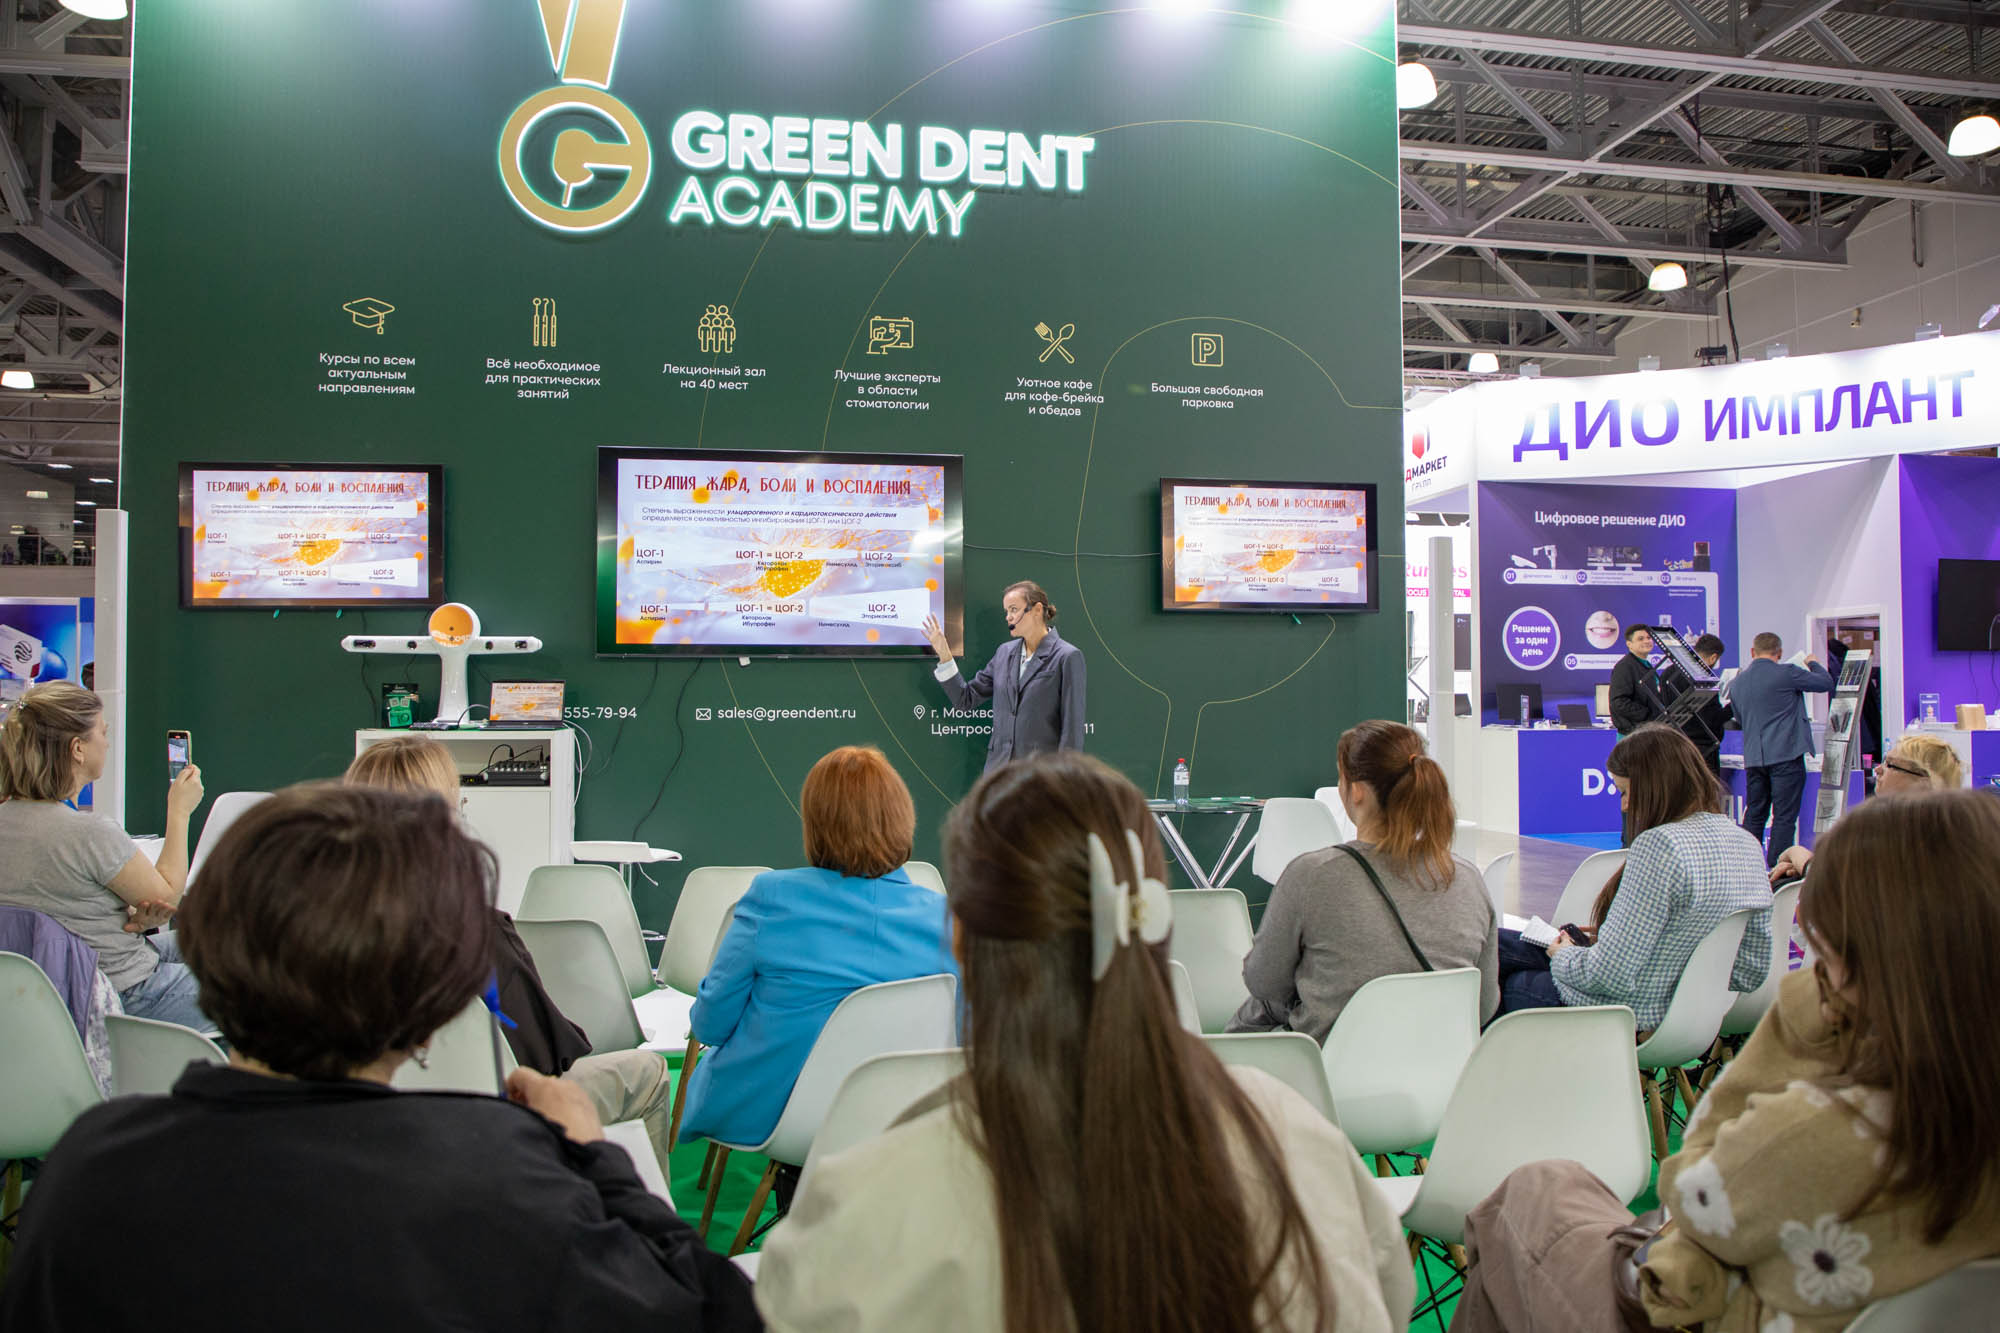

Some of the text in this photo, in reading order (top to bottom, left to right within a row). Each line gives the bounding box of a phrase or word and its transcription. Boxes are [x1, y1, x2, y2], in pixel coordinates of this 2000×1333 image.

[671, 110, 1096, 190] GREEN DENT
[669, 175, 975, 236] ACADEMY
[319, 352, 416, 366] Курсы по всем
[486, 358, 600, 372] Всё необходимое
[327, 369, 407, 381] актуальным
[662, 363, 766, 377] Лекционный зал
[485, 374, 601, 386] для практических
[833, 369, 941, 384] Лучшие эксперты
[318, 383, 415, 395] направлениям
[680, 379, 749, 390] на 40 мест
[1016, 376, 1093, 391] Уютное кафе
[1151, 382, 1264, 397] Большая свободная
[517, 388, 569, 399] занятий
[857, 384, 918, 396] в области
[1004, 391, 1105, 404] для кофе-брейка
[845, 399, 930, 410] стоматологии
[1028, 404, 1082, 416] и обедов
[1182, 399, 1234, 410] парковка
[1512, 370, 1976, 463] ДИО ИМПЛАНТ
[206, 481, 404, 494] ТЕРАПИЯ ЖАРА, БОЛИ И ВОСПАЛЕНИЯ
[634, 474, 911, 495] ТЕРАПИЯ ЖАРА, БОЛИ И ВОСПАЛЕНИЯ
[1184, 495, 1220, 506] ТЕРАПИЯ
[1257, 497, 1279, 508] БОЛИ
[1284, 498, 1289, 508] И
[642, 507, 672, 516] Степень
[673, 508, 725, 517] выраженности
[791, 510, 863, 518] кардиотоксического
[642, 515, 692, 523] определяется
[1534, 511, 1686, 528] Цифровое решение ДИО
[636, 549, 664, 558] ЦОГ-1
[736, 550, 763, 559] ЦОГ-1
[775, 551, 803, 560] ЦОГ-2
[865, 552, 893, 562] ЦОГ-2
[640, 605, 668, 614] ЦОГ-1
[736, 604, 763, 613] ЦОГ-1
[775, 604, 803, 613] ЦОГ-2
[868, 603, 896, 612] ЦОГ-2
[1512, 623, 1551, 633] Решение
[1515, 636, 1548, 646] за один
[1521, 648, 1543, 658] день
[563, 707, 638, 719] 555-79-94
[717, 706, 856, 721] sales@greendent.ru
[930, 708, 939, 719] г.
